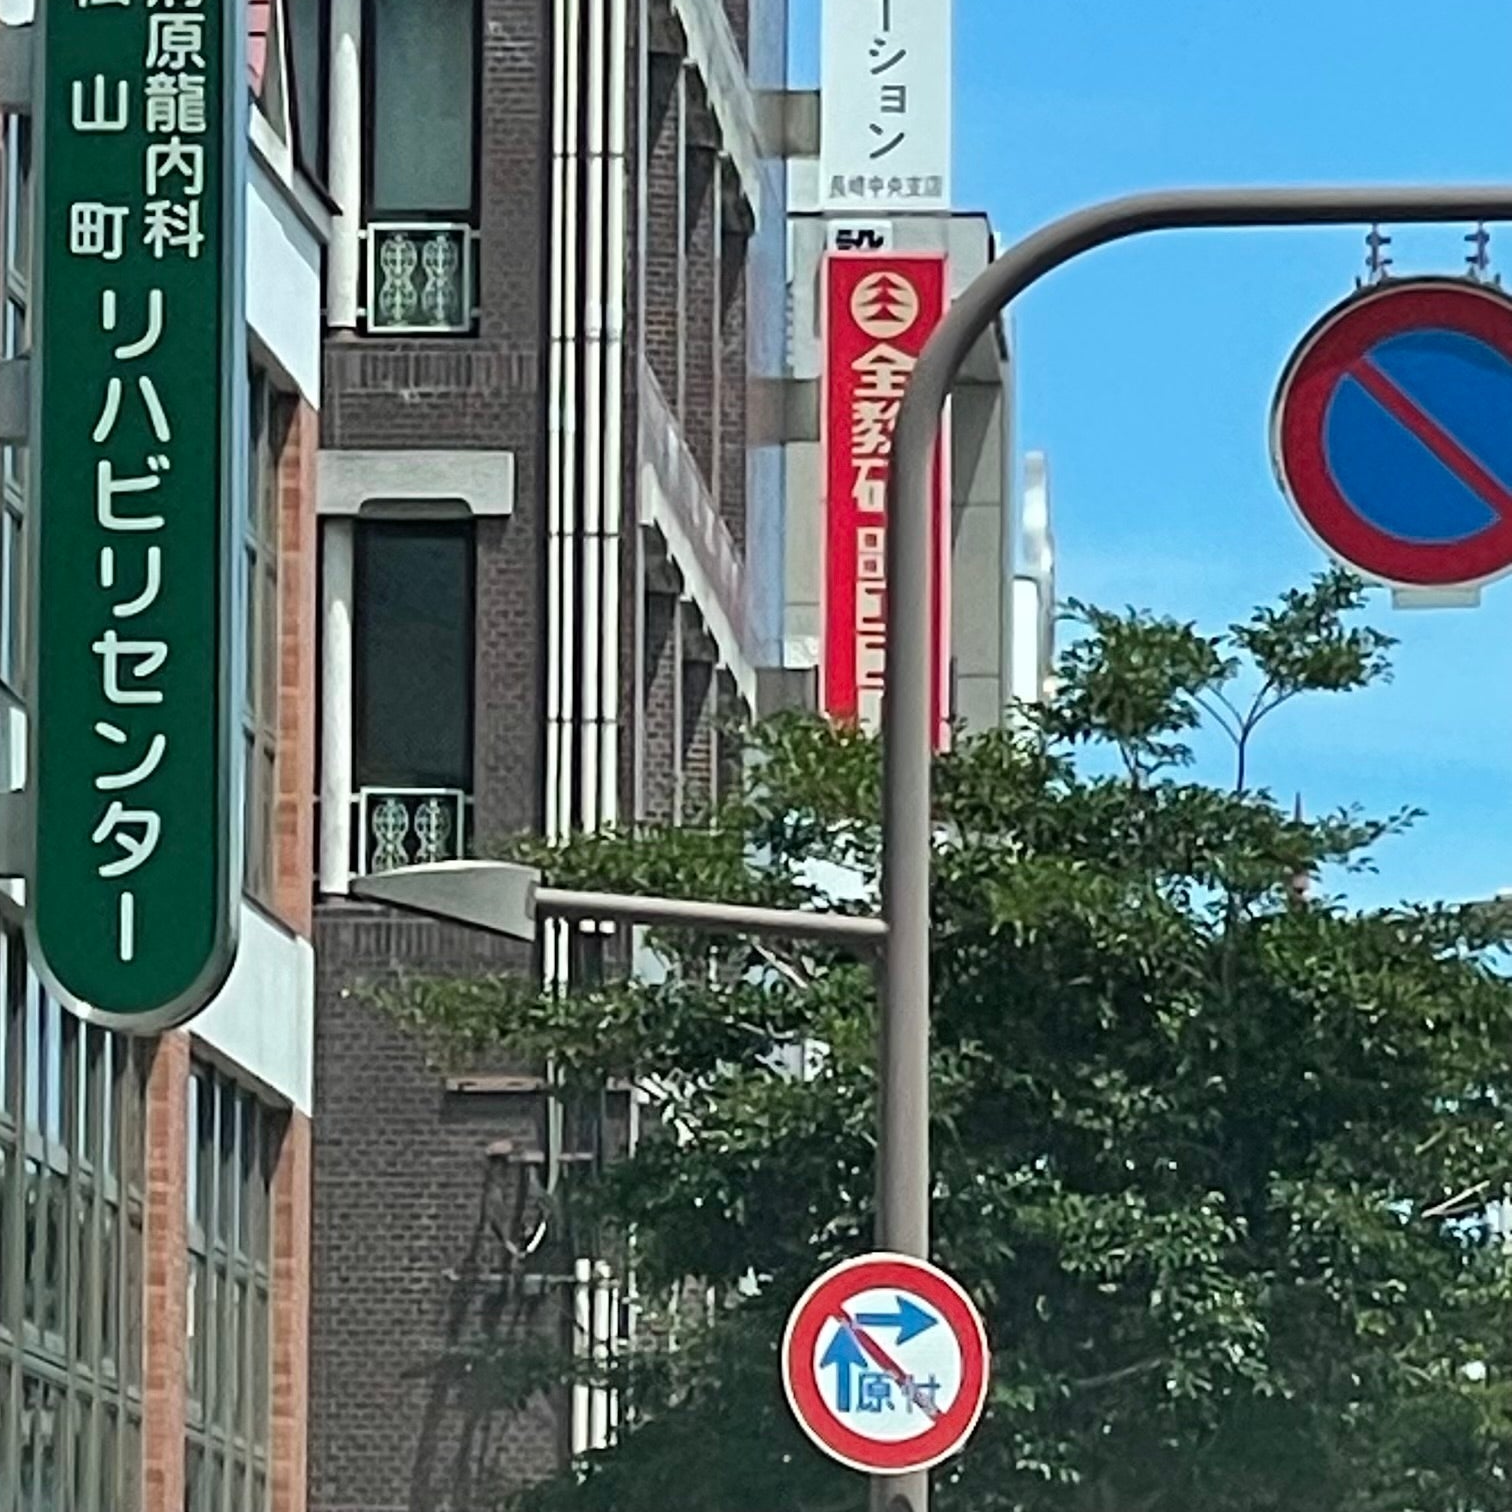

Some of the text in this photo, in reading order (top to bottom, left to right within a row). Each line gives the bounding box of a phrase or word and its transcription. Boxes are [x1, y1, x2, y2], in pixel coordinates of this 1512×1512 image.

[92, 289, 170, 961] リハビリセンター
[855, 1372, 941, 1414] 原付
